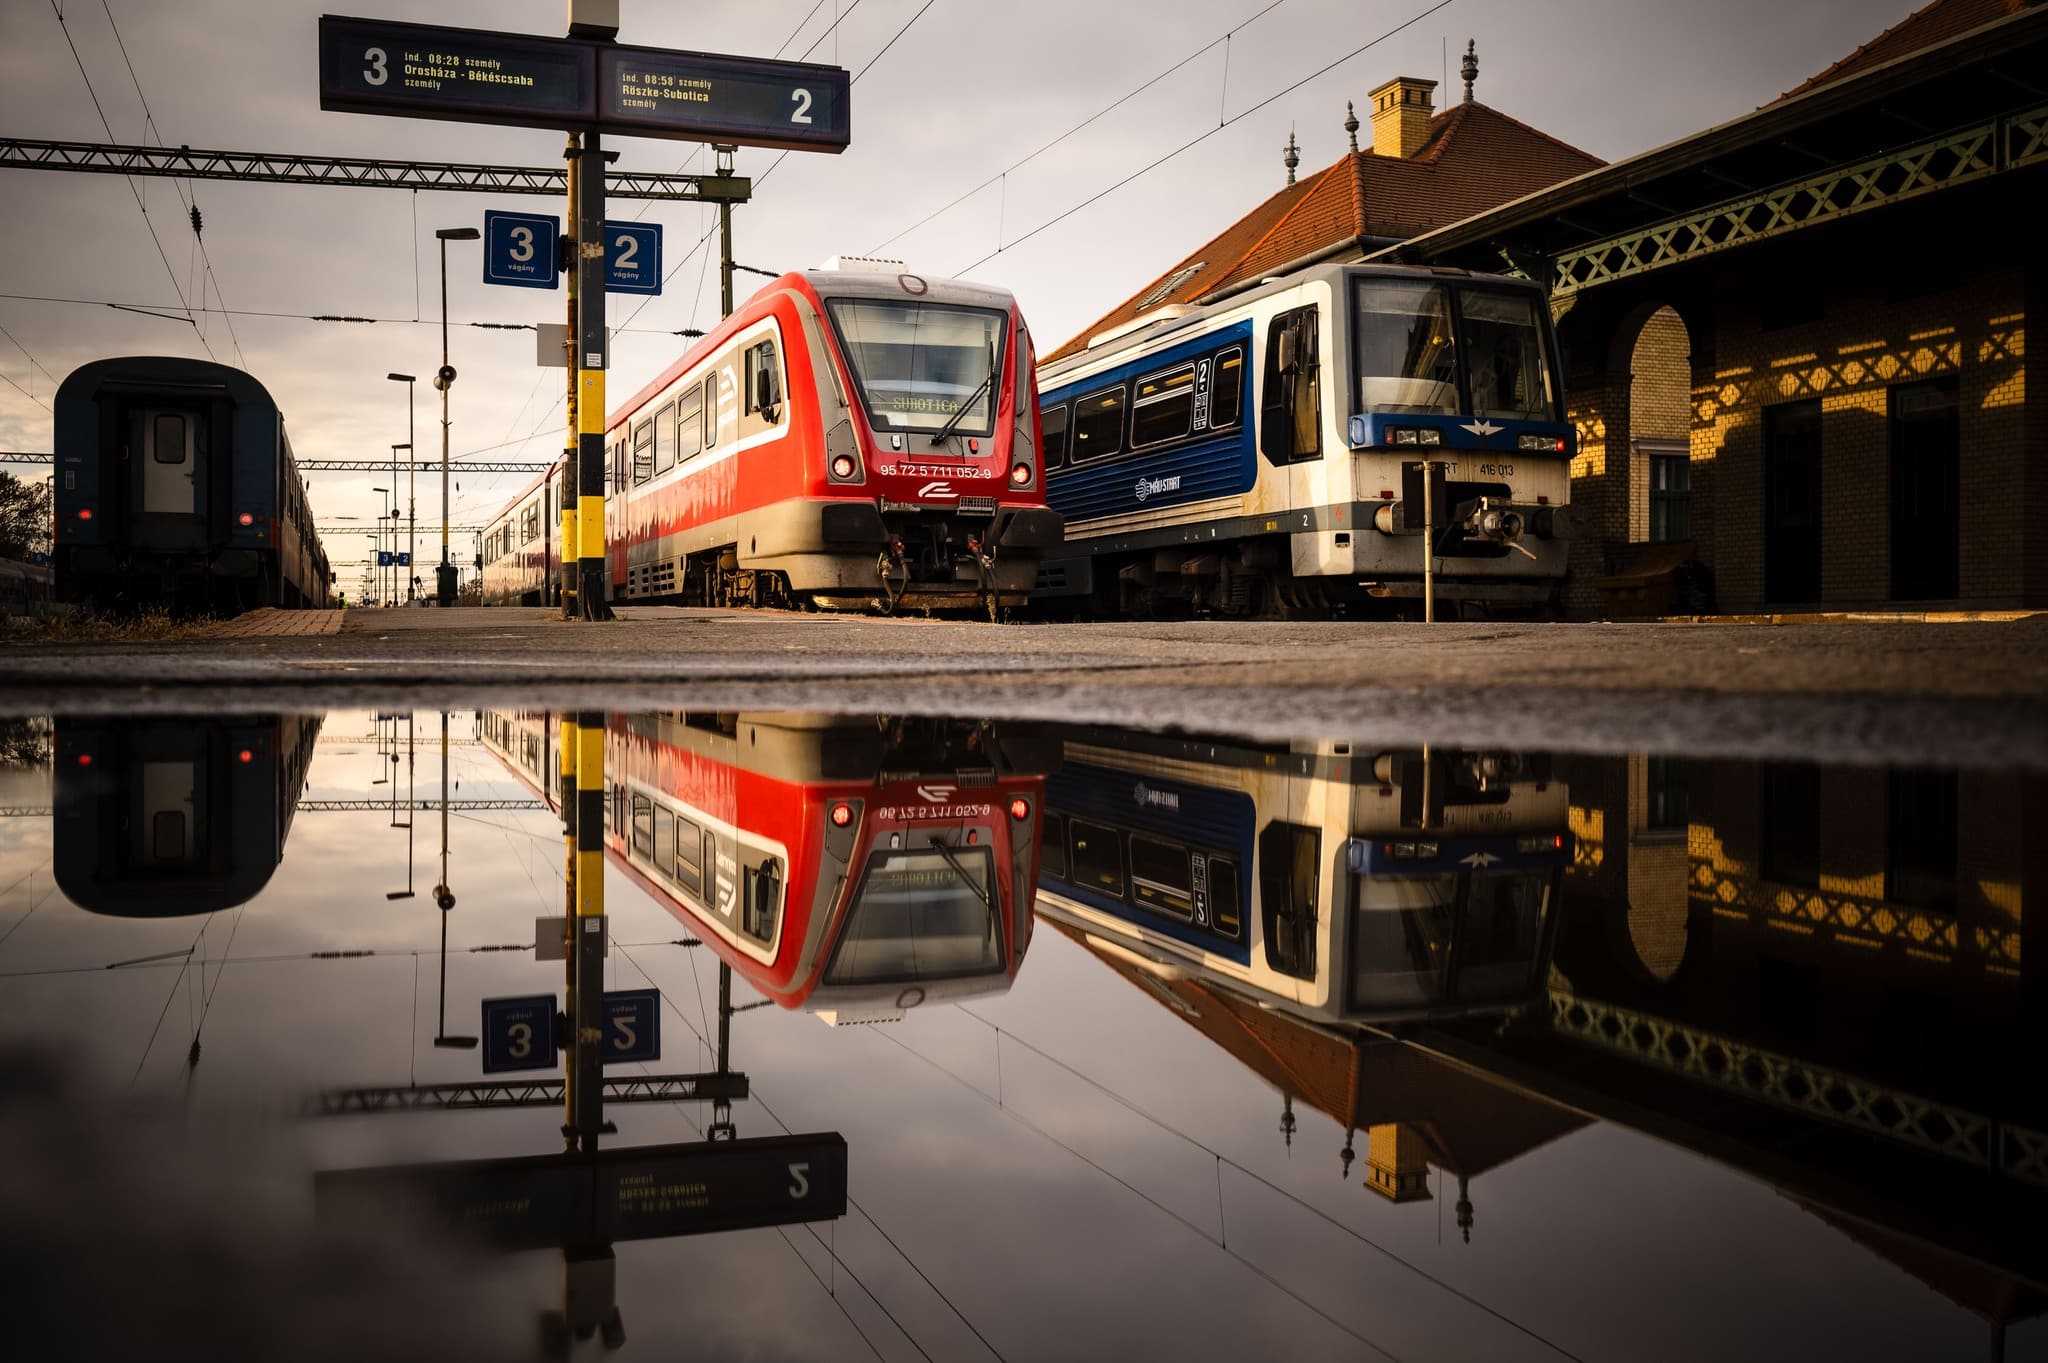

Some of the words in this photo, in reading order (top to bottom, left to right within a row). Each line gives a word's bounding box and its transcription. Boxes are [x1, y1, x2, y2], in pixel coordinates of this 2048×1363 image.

[363, 47, 389, 86] 3
[404, 51, 422, 62] ind.
[428, 53, 460, 66] 08:28
[465, 59, 501, 70] személy
[404, 64, 457, 79] Orosháza
[468, 70, 534, 86] Békéscsaba
[622, 73, 639, 83] ind.
[644, 75, 674, 86] 08:58
[679, 79, 712, 90] személy
[404, 78, 441, 91] személy
[622, 85, 709, 103] Röszke-Subotica
[623, 99, 657, 110] személy
[791, 88, 813, 124] 2
[509, 226, 534, 262] 3
[615, 234, 639, 269] 2
[508, 263, 535, 273] vágány
[613, 271, 640, 280] vágány
[1199, 363, 1207, 383] 2
[880, 465, 896, 476] 95
[899, 465, 916, 476] 72
[920, 465, 928, 476] 5
[931, 466, 953, 477] 711
[957, 467, 992, 479] 052-9
[1480, 464, 1496, 476] 416
[1498, 464, 1514, 476] 013
[1303, 514, 1309, 527] 2
[383, 554, 389, 562] 3
[403, 555, 409, 563] 2
